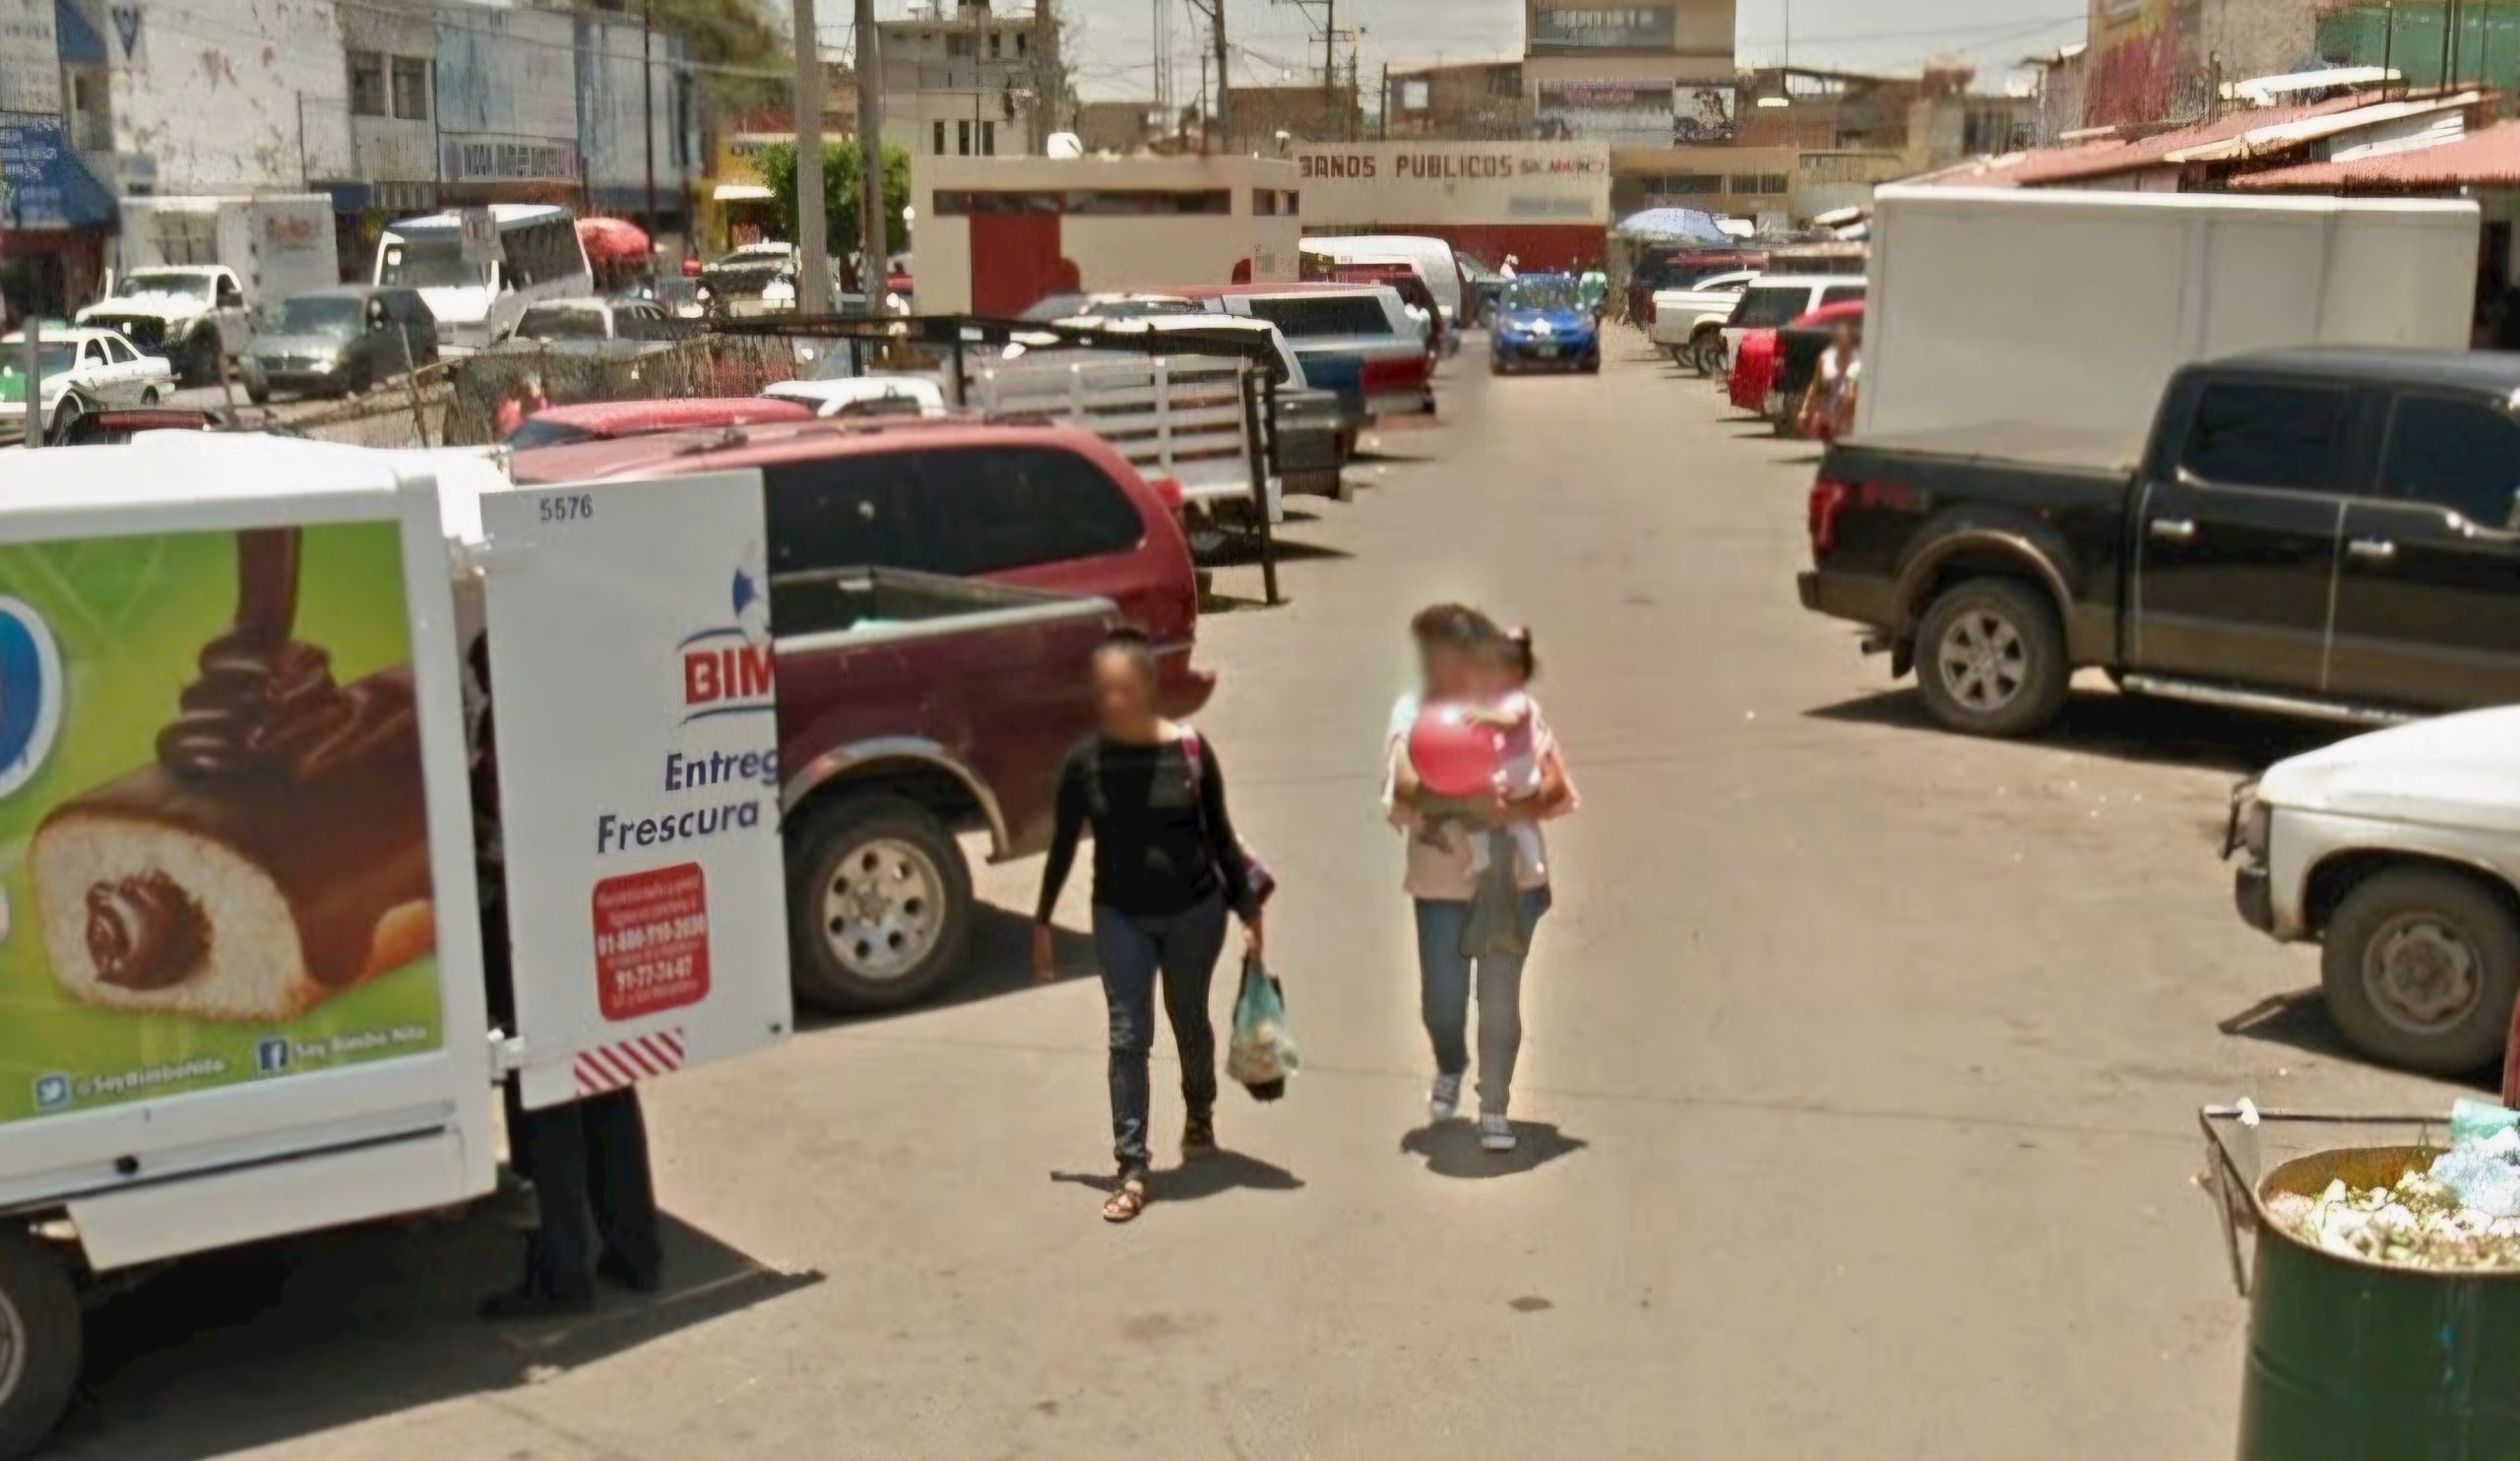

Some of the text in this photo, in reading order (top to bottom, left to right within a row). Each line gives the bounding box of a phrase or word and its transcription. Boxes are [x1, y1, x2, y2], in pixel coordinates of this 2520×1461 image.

[1395, 154, 1513, 178] PUBLICOS
[539, 494, 594, 522] 5576
[597, 800, 760, 855] Frescura
